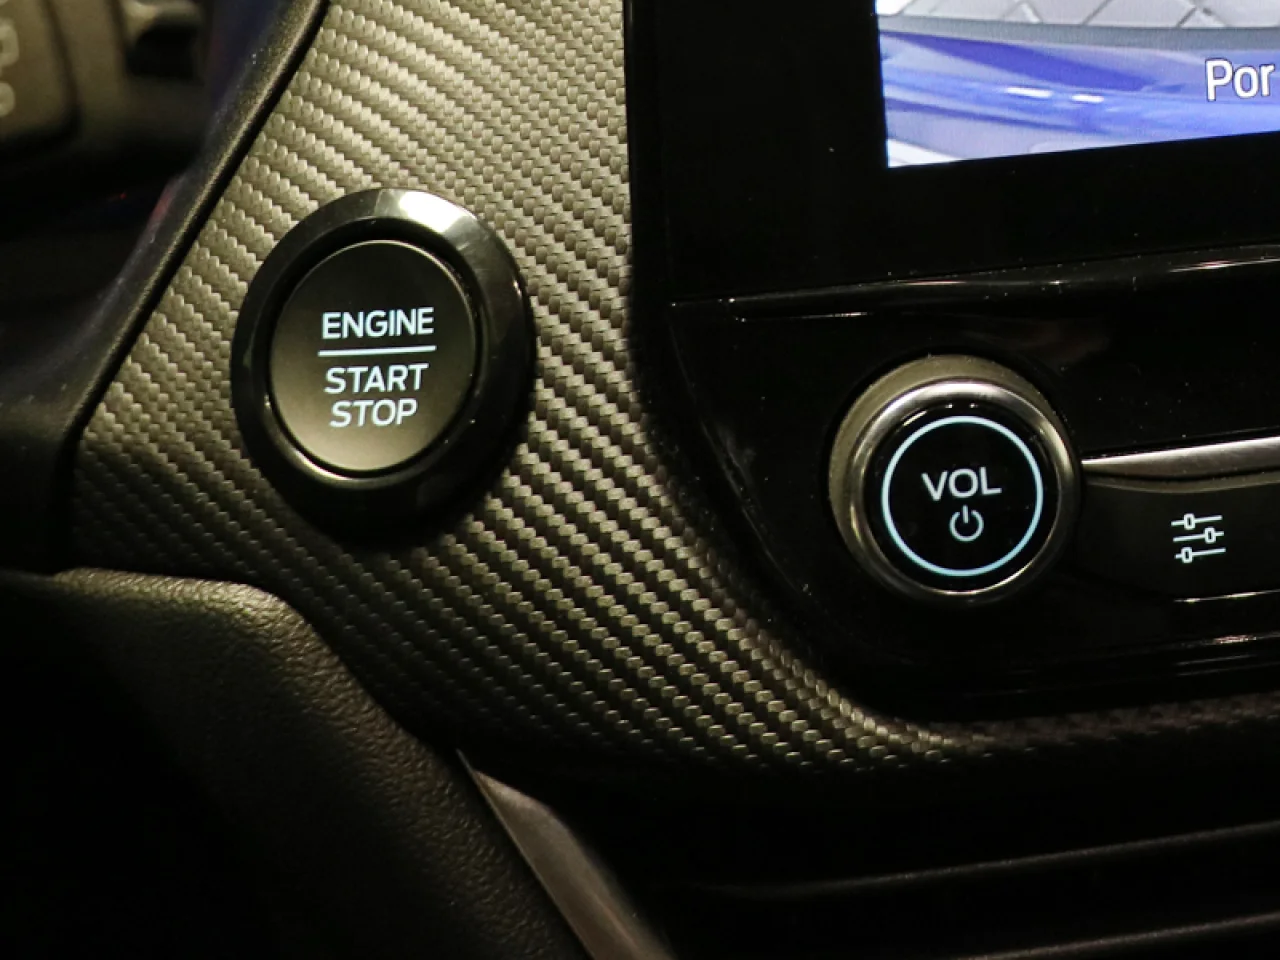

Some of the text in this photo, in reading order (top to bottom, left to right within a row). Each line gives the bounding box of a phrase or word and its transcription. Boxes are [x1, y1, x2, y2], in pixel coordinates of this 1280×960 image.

[1206, 58, 1275, 101] Por
[322, 307, 434, 339] ENGINE
[323, 363, 429, 394] START
[329, 398, 418, 427] STOP
[921, 466, 1003, 501] VOL
